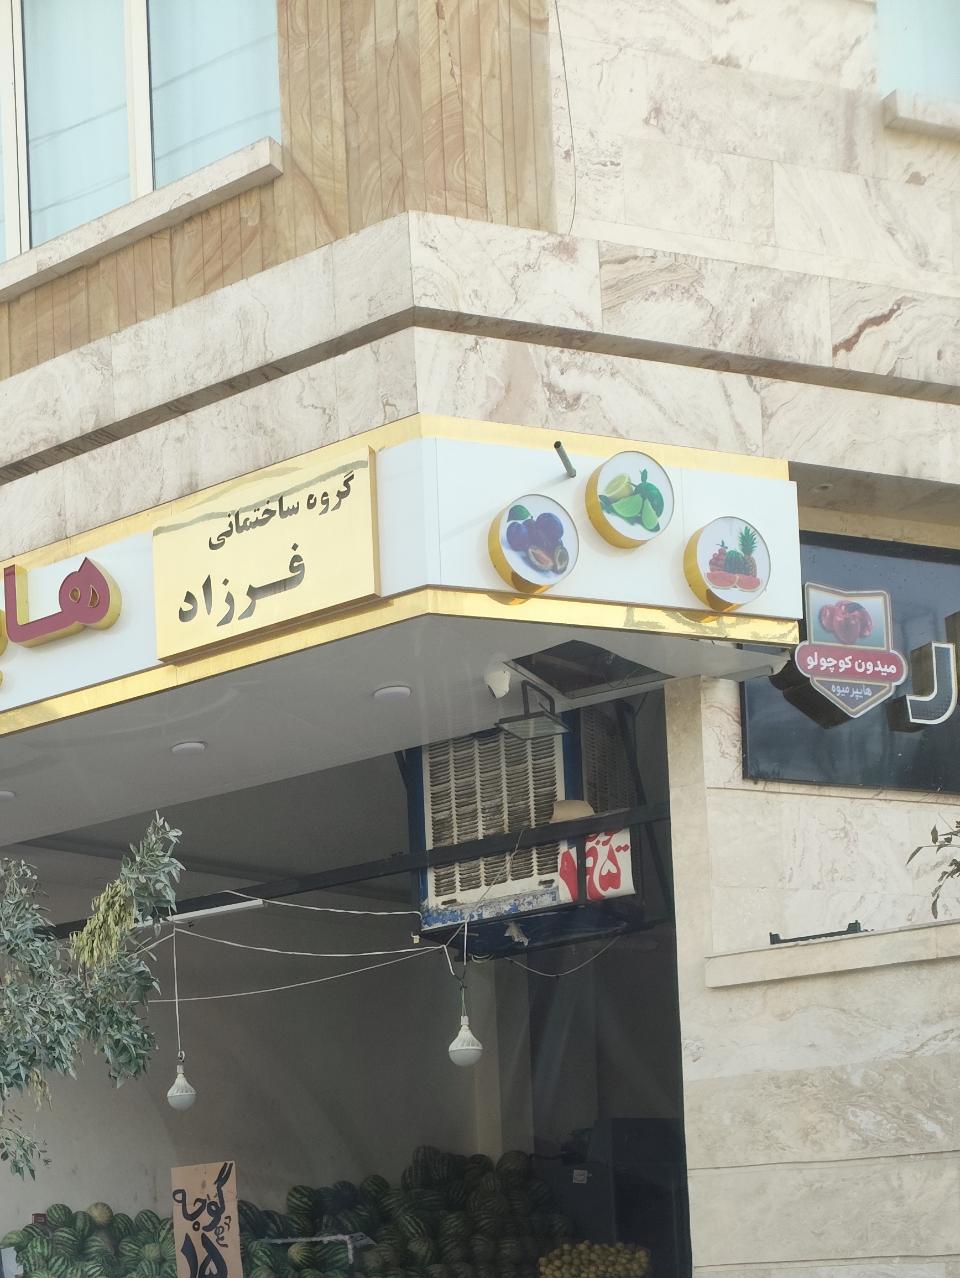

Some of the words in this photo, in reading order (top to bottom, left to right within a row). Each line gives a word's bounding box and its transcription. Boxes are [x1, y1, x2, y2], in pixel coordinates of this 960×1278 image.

[307, 470, 355, 516] گروه
[208, 495, 300, 550] ساختمانی
[178, 543, 305, 627] فرزاد
[806, 651, 853, 673] کوچولو
[854, 659, 897, 675] میدون
[173, 1162, 233, 1232] گوجه
